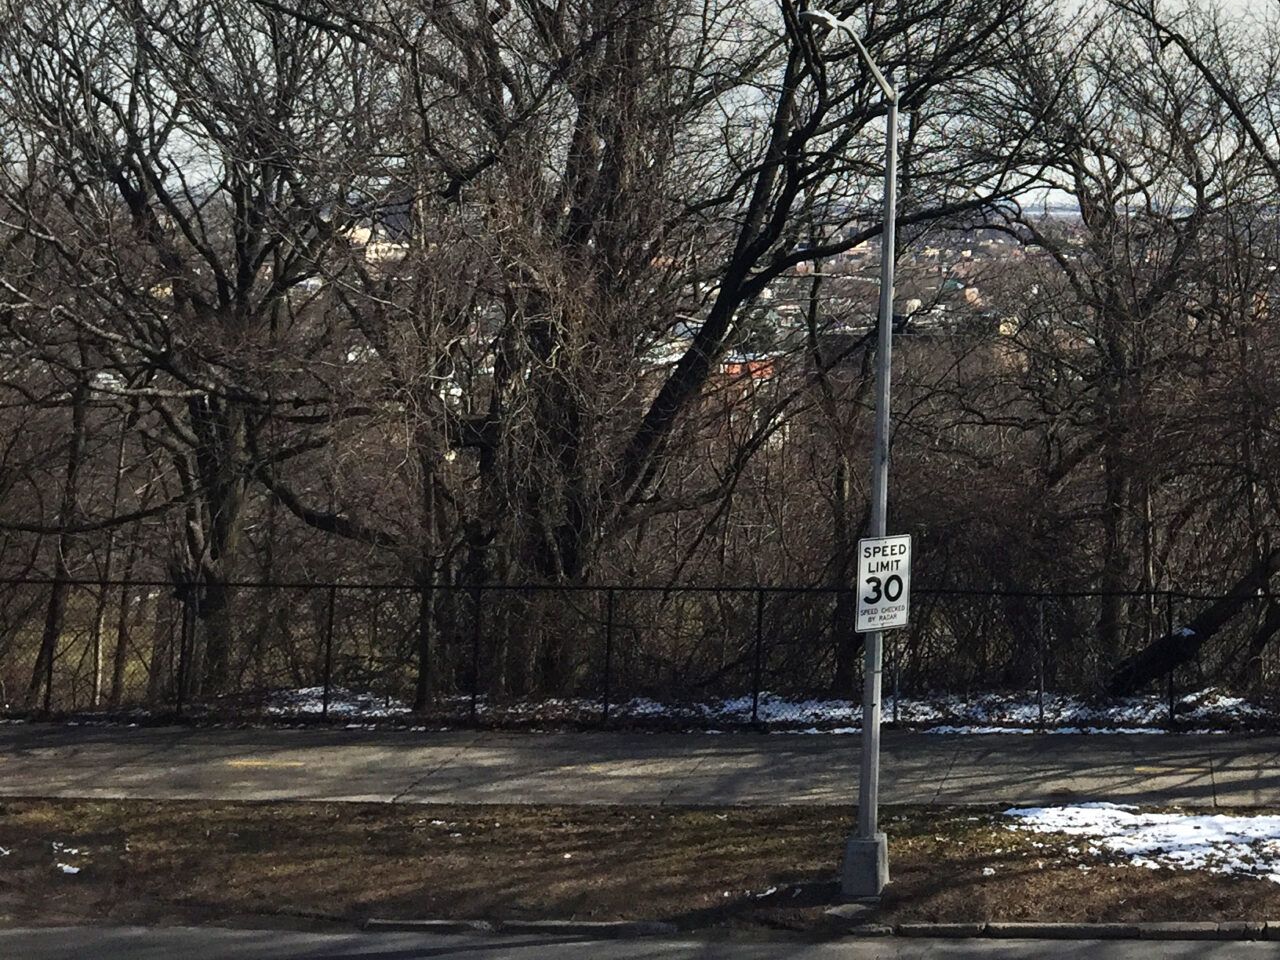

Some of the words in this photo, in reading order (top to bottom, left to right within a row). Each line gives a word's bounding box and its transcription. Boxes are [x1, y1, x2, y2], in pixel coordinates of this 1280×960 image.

[864, 544, 906, 558] SPEED
[868, 560, 901, 573] LIMIT
[863, 574, 903, 605] 30
[860, 608, 878, 616] SPEED
